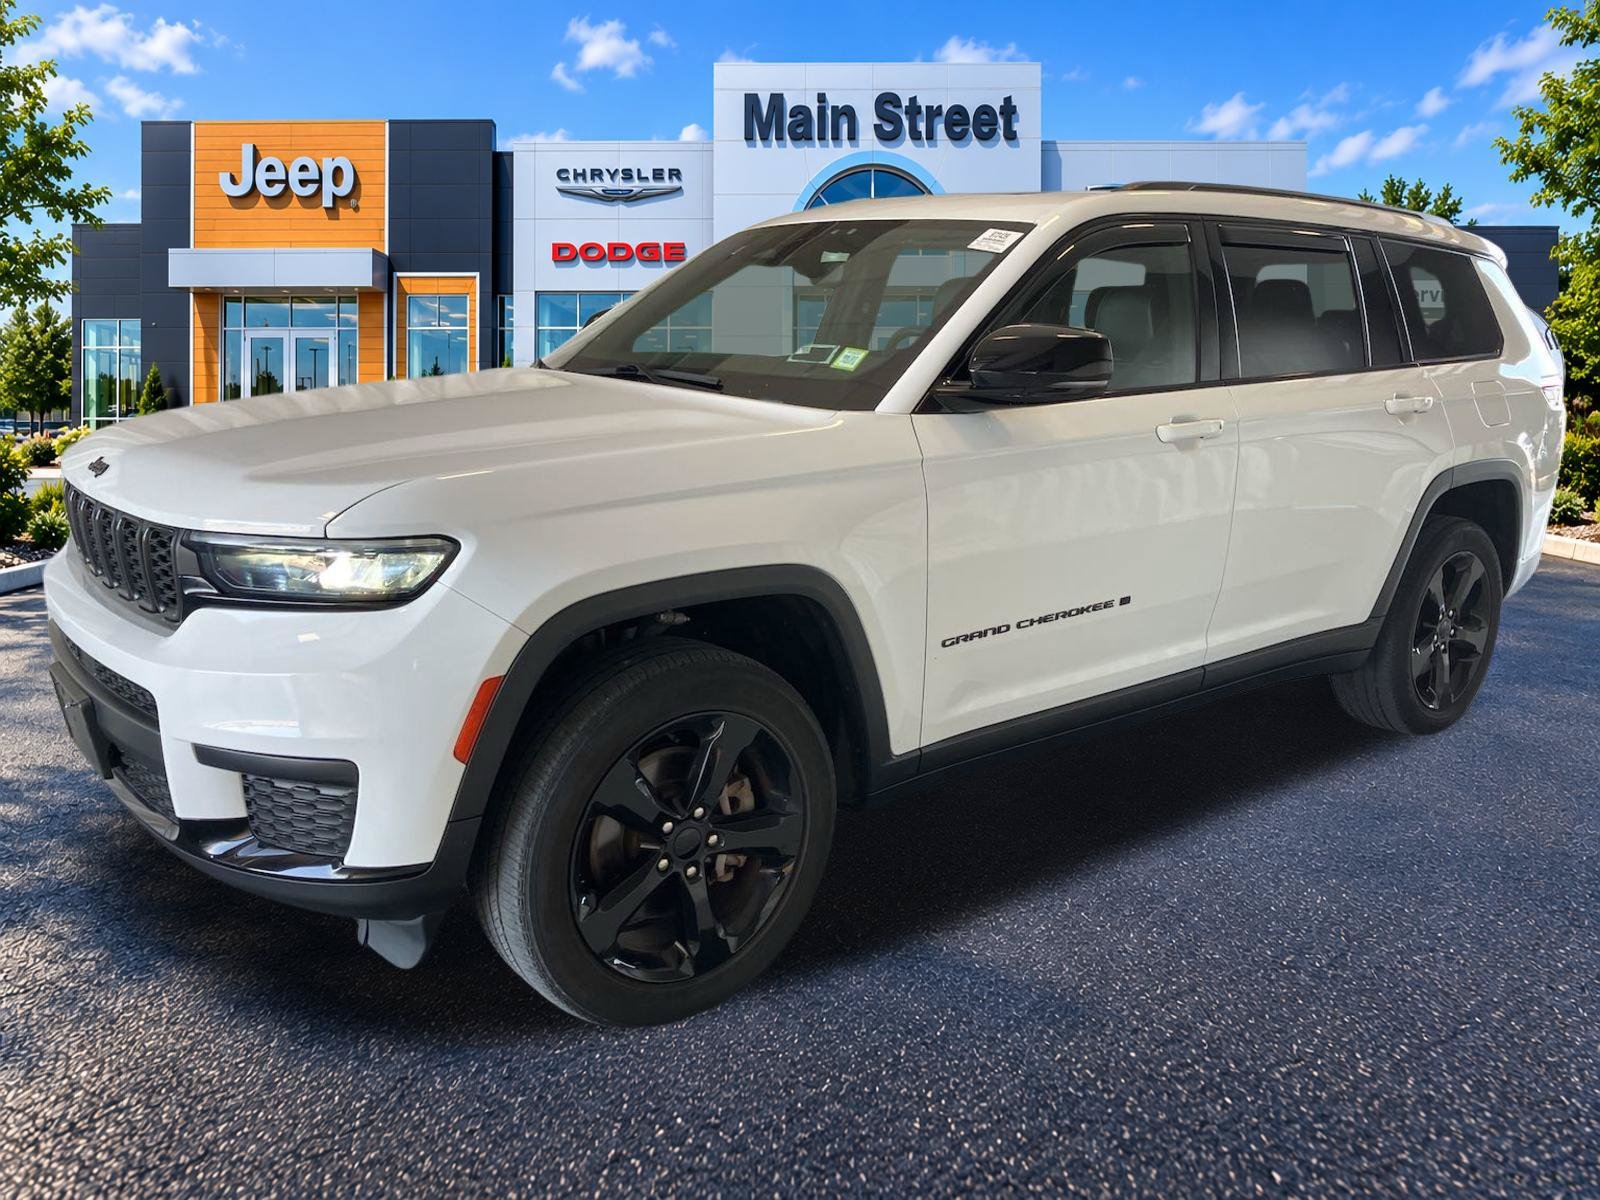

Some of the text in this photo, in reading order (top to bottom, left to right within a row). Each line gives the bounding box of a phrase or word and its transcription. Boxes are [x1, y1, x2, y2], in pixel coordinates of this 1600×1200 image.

[744, 91, 1017, 141] Main Street
[218, 143, 355, 208] Jeep
[556, 168, 683, 182] CHRYSLER
[551, 242, 687, 261] DODGE
[941, 599, 1115, 648] GRAND CHEROKEE
